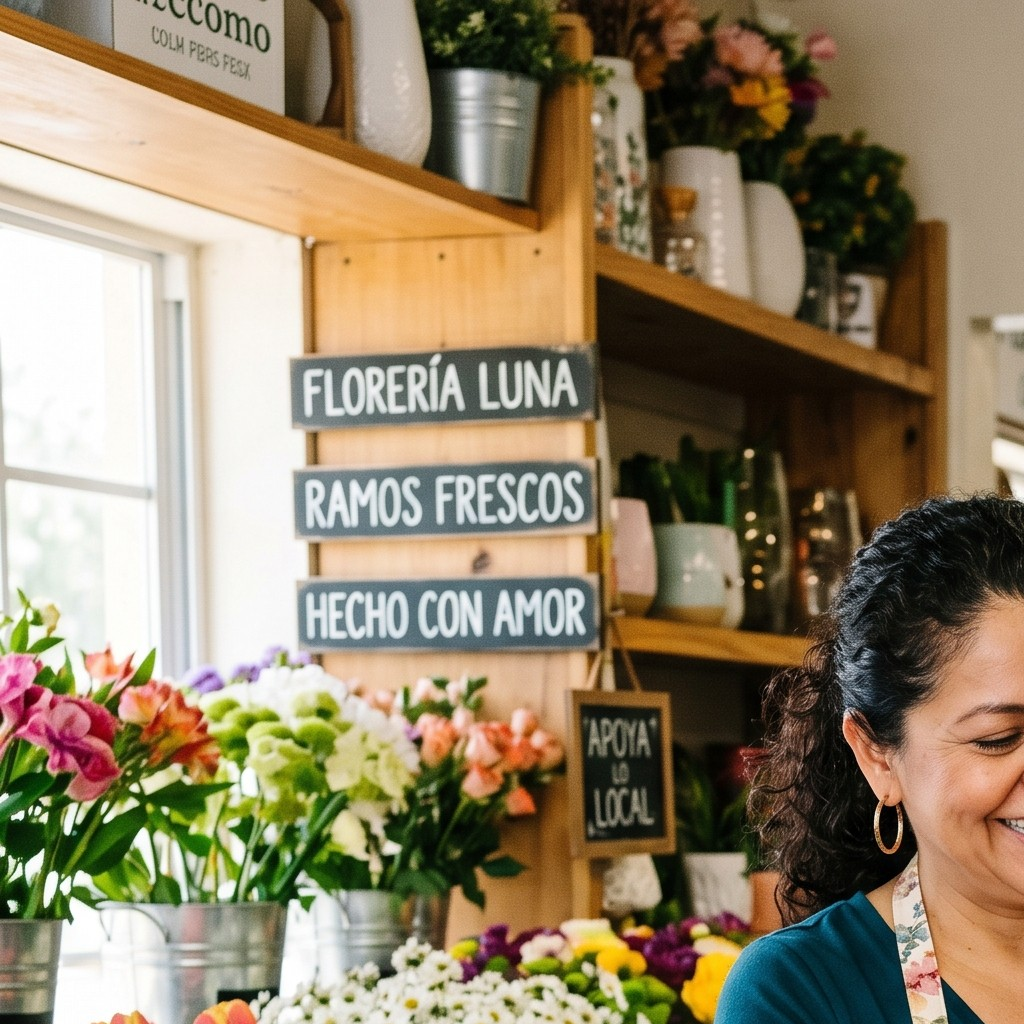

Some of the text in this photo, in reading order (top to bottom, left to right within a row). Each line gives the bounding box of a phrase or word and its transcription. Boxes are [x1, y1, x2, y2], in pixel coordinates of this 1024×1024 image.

[303, 353, 579, 417] FLORERÍA LUNA
[305, 471, 585, 529] RAMOS FRESCOS
[306, 587, 587, 640] HECHO CON AMOR
[594, 786, 655, 829] LOCAL
